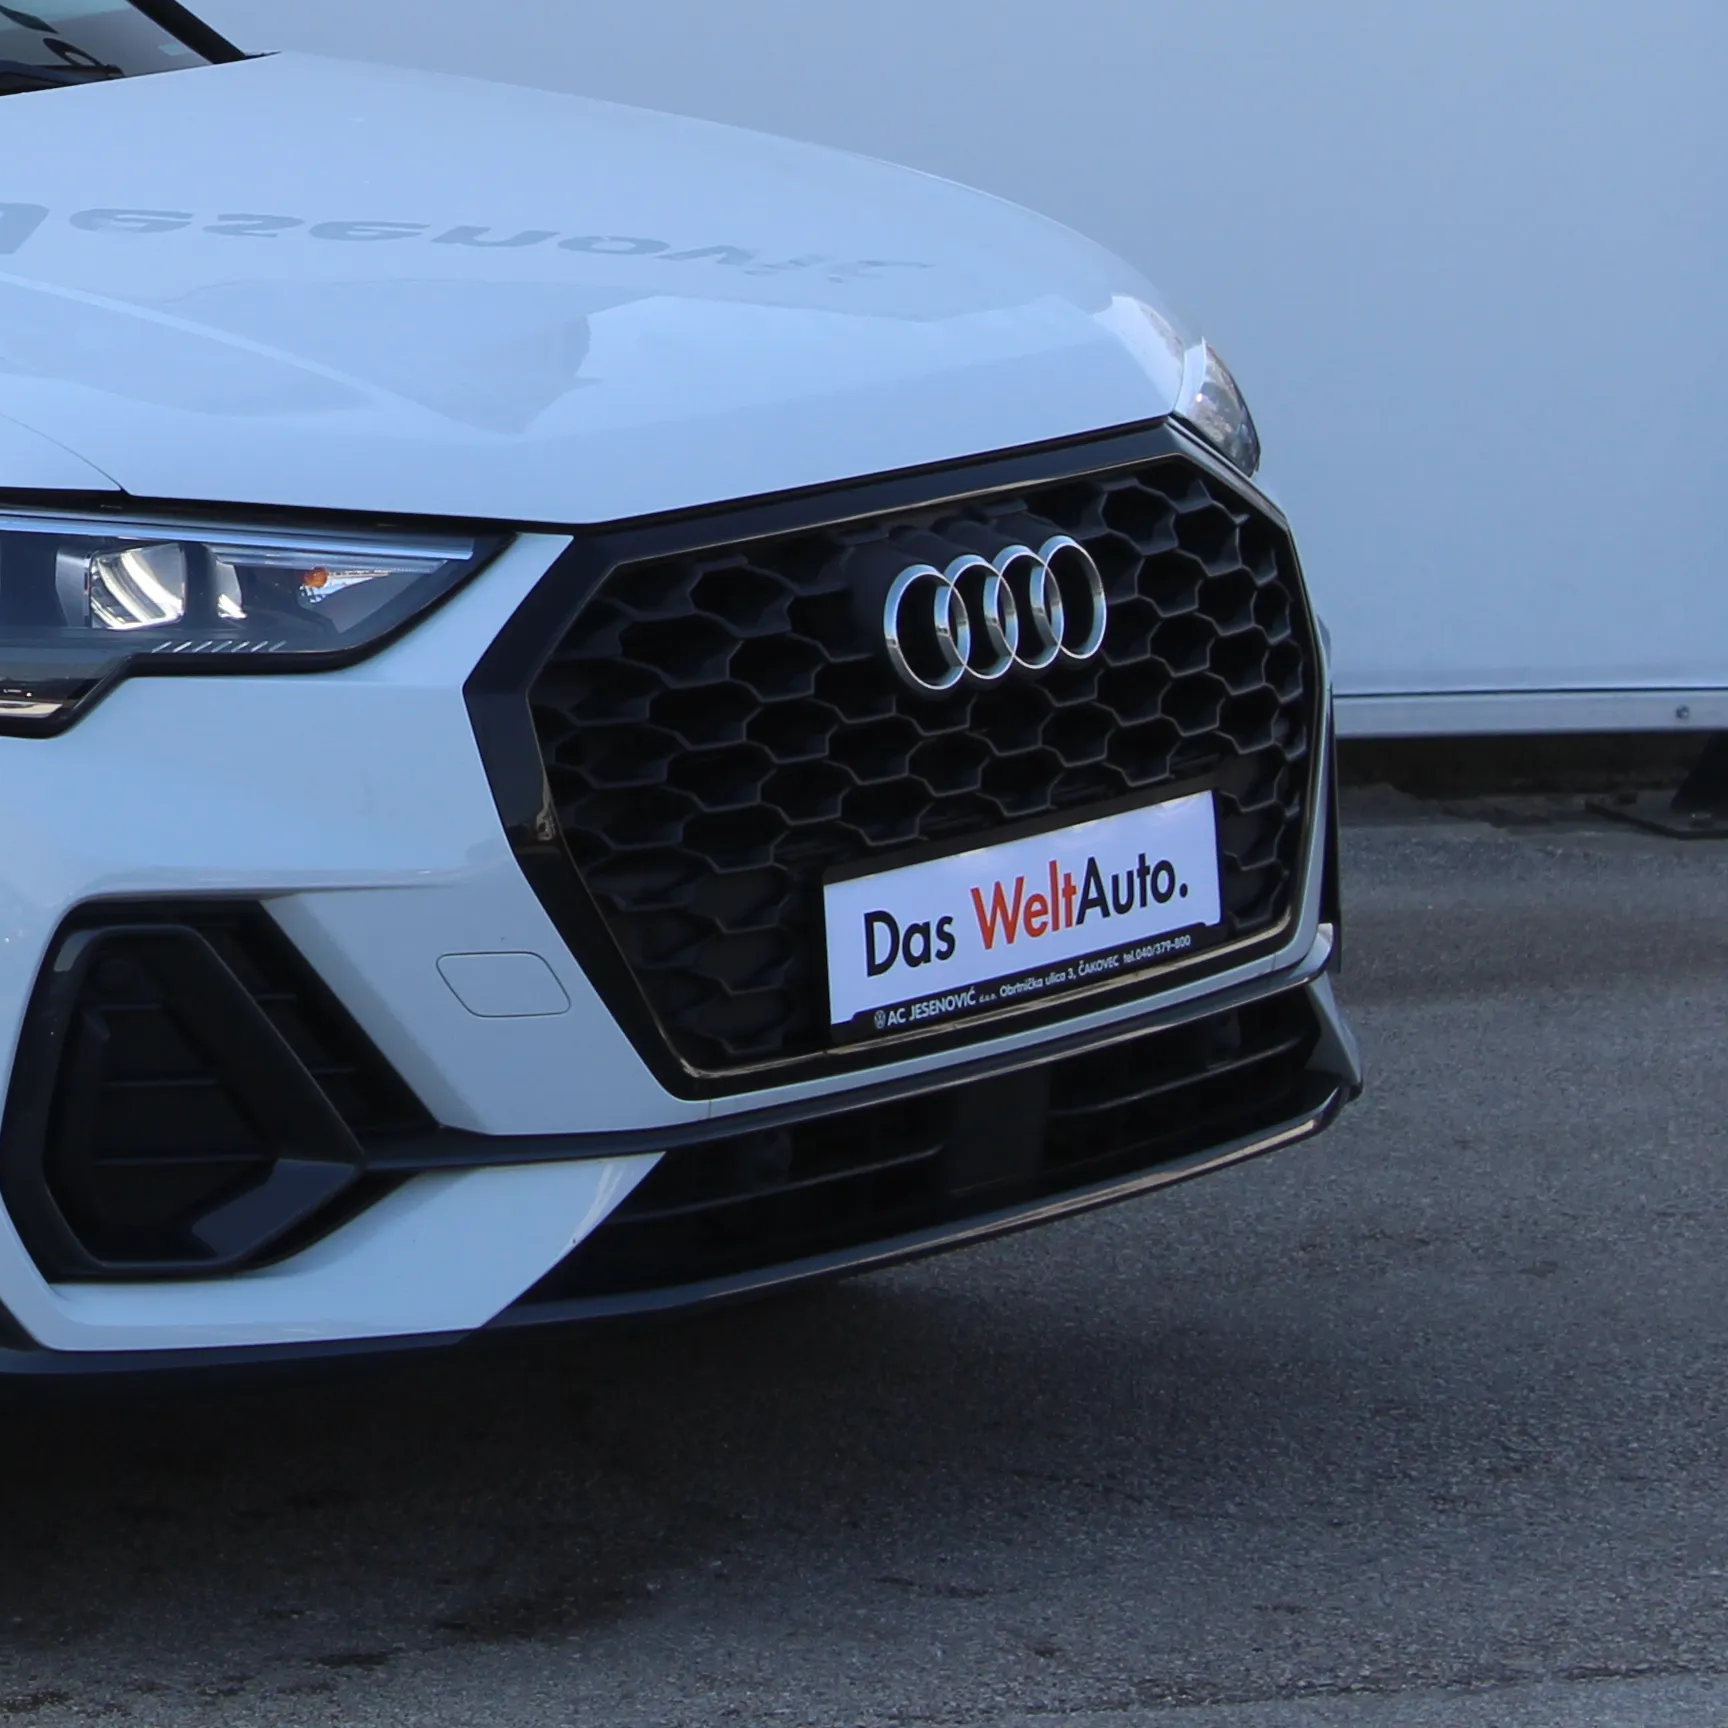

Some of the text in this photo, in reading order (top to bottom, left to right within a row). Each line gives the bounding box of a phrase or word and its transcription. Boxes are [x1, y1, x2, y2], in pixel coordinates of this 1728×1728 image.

[863, 852, 1188, 977] Das WeltAuto.
[887, 1008, 906, 1026] AC
[908, 986, 976, 1021] JESENOVIĆ
